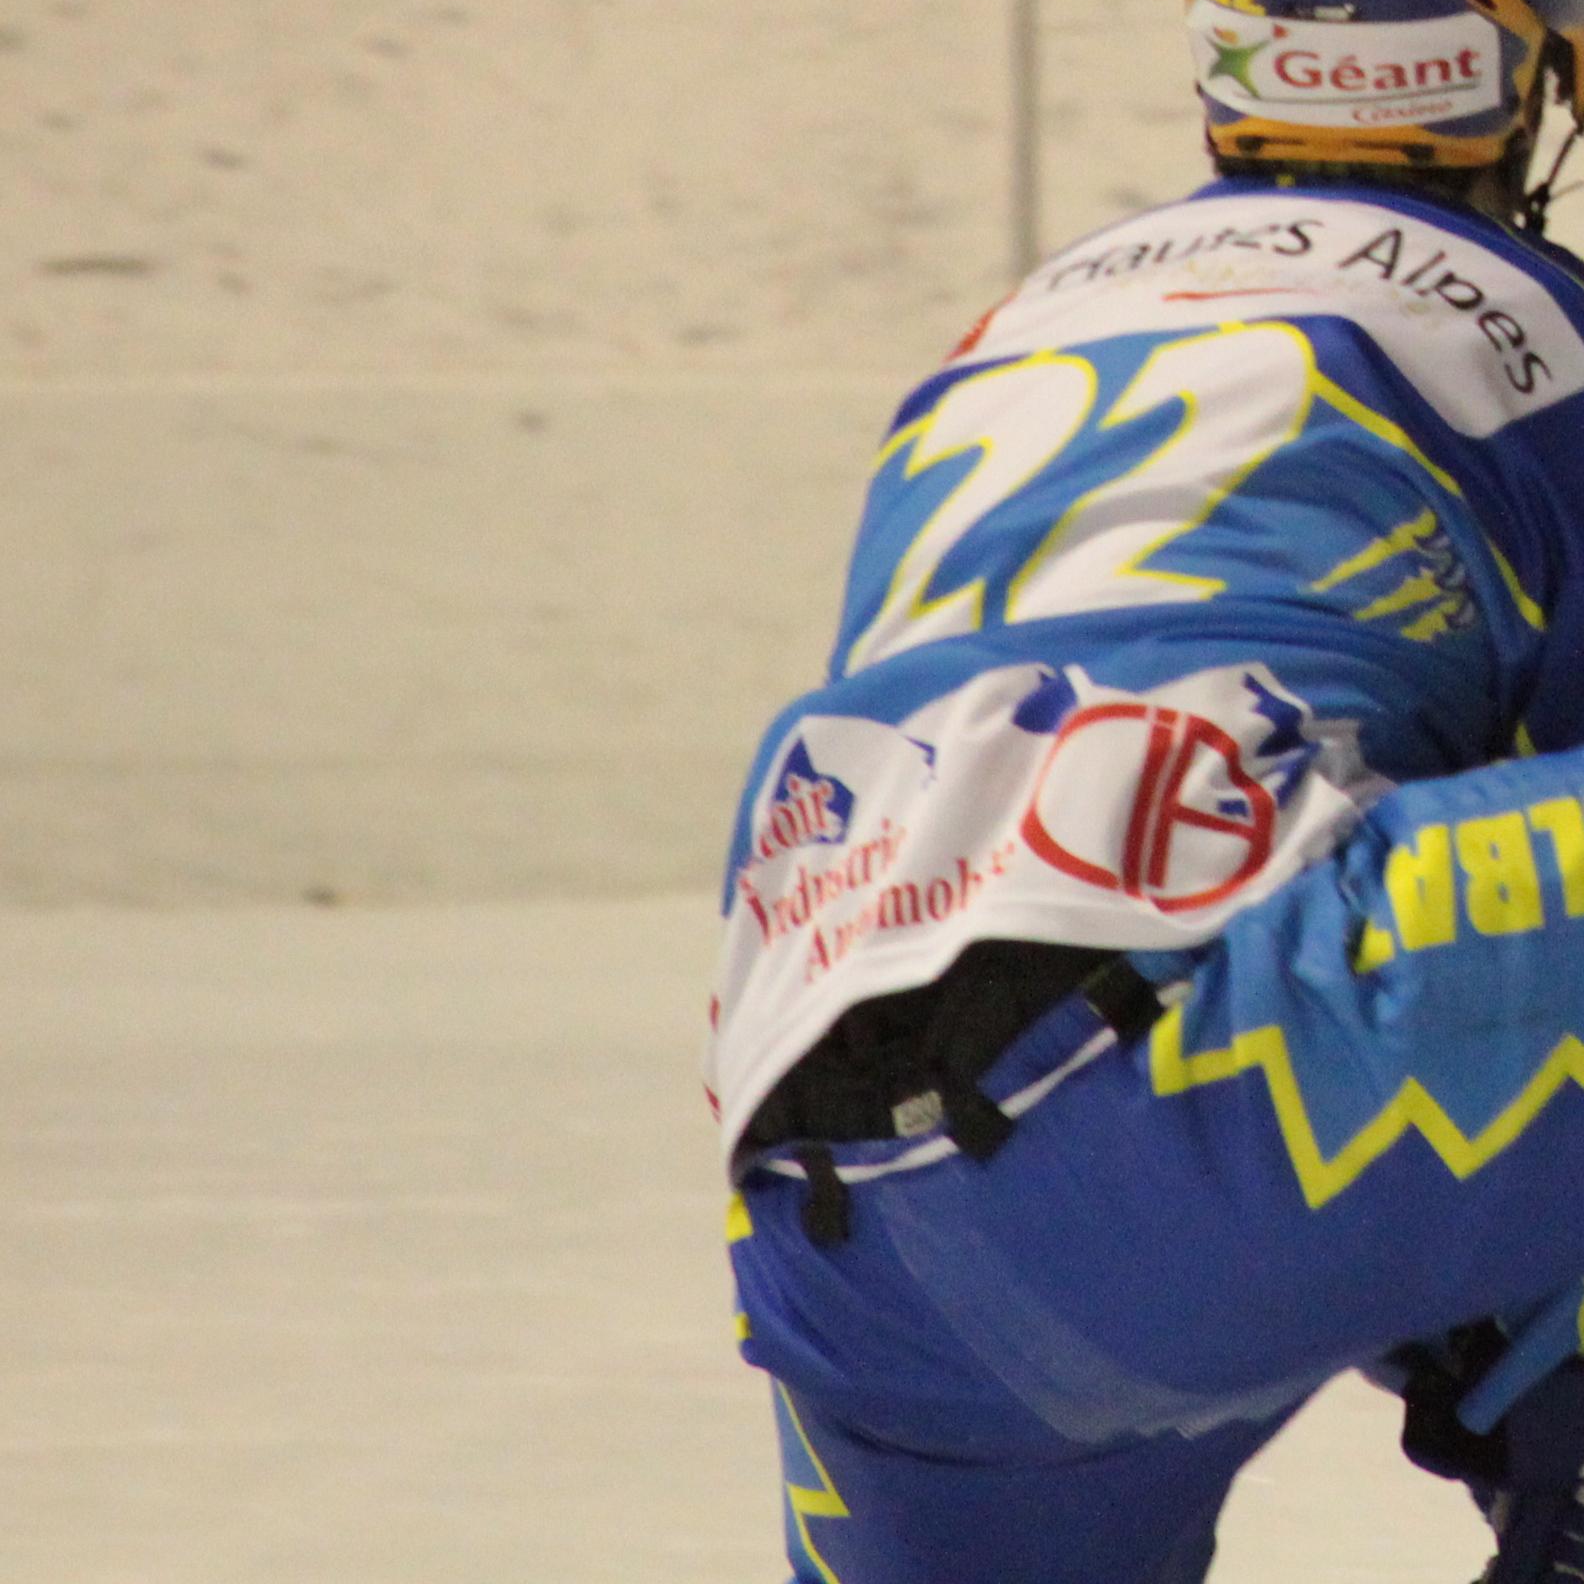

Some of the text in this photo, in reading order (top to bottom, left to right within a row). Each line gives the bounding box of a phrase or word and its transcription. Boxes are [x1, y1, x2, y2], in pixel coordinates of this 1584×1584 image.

[1272, 45, 1482, 92] Géant
[1338, 227, 1553, 395] Alpes
[845, 319, 1318, 679] 22
